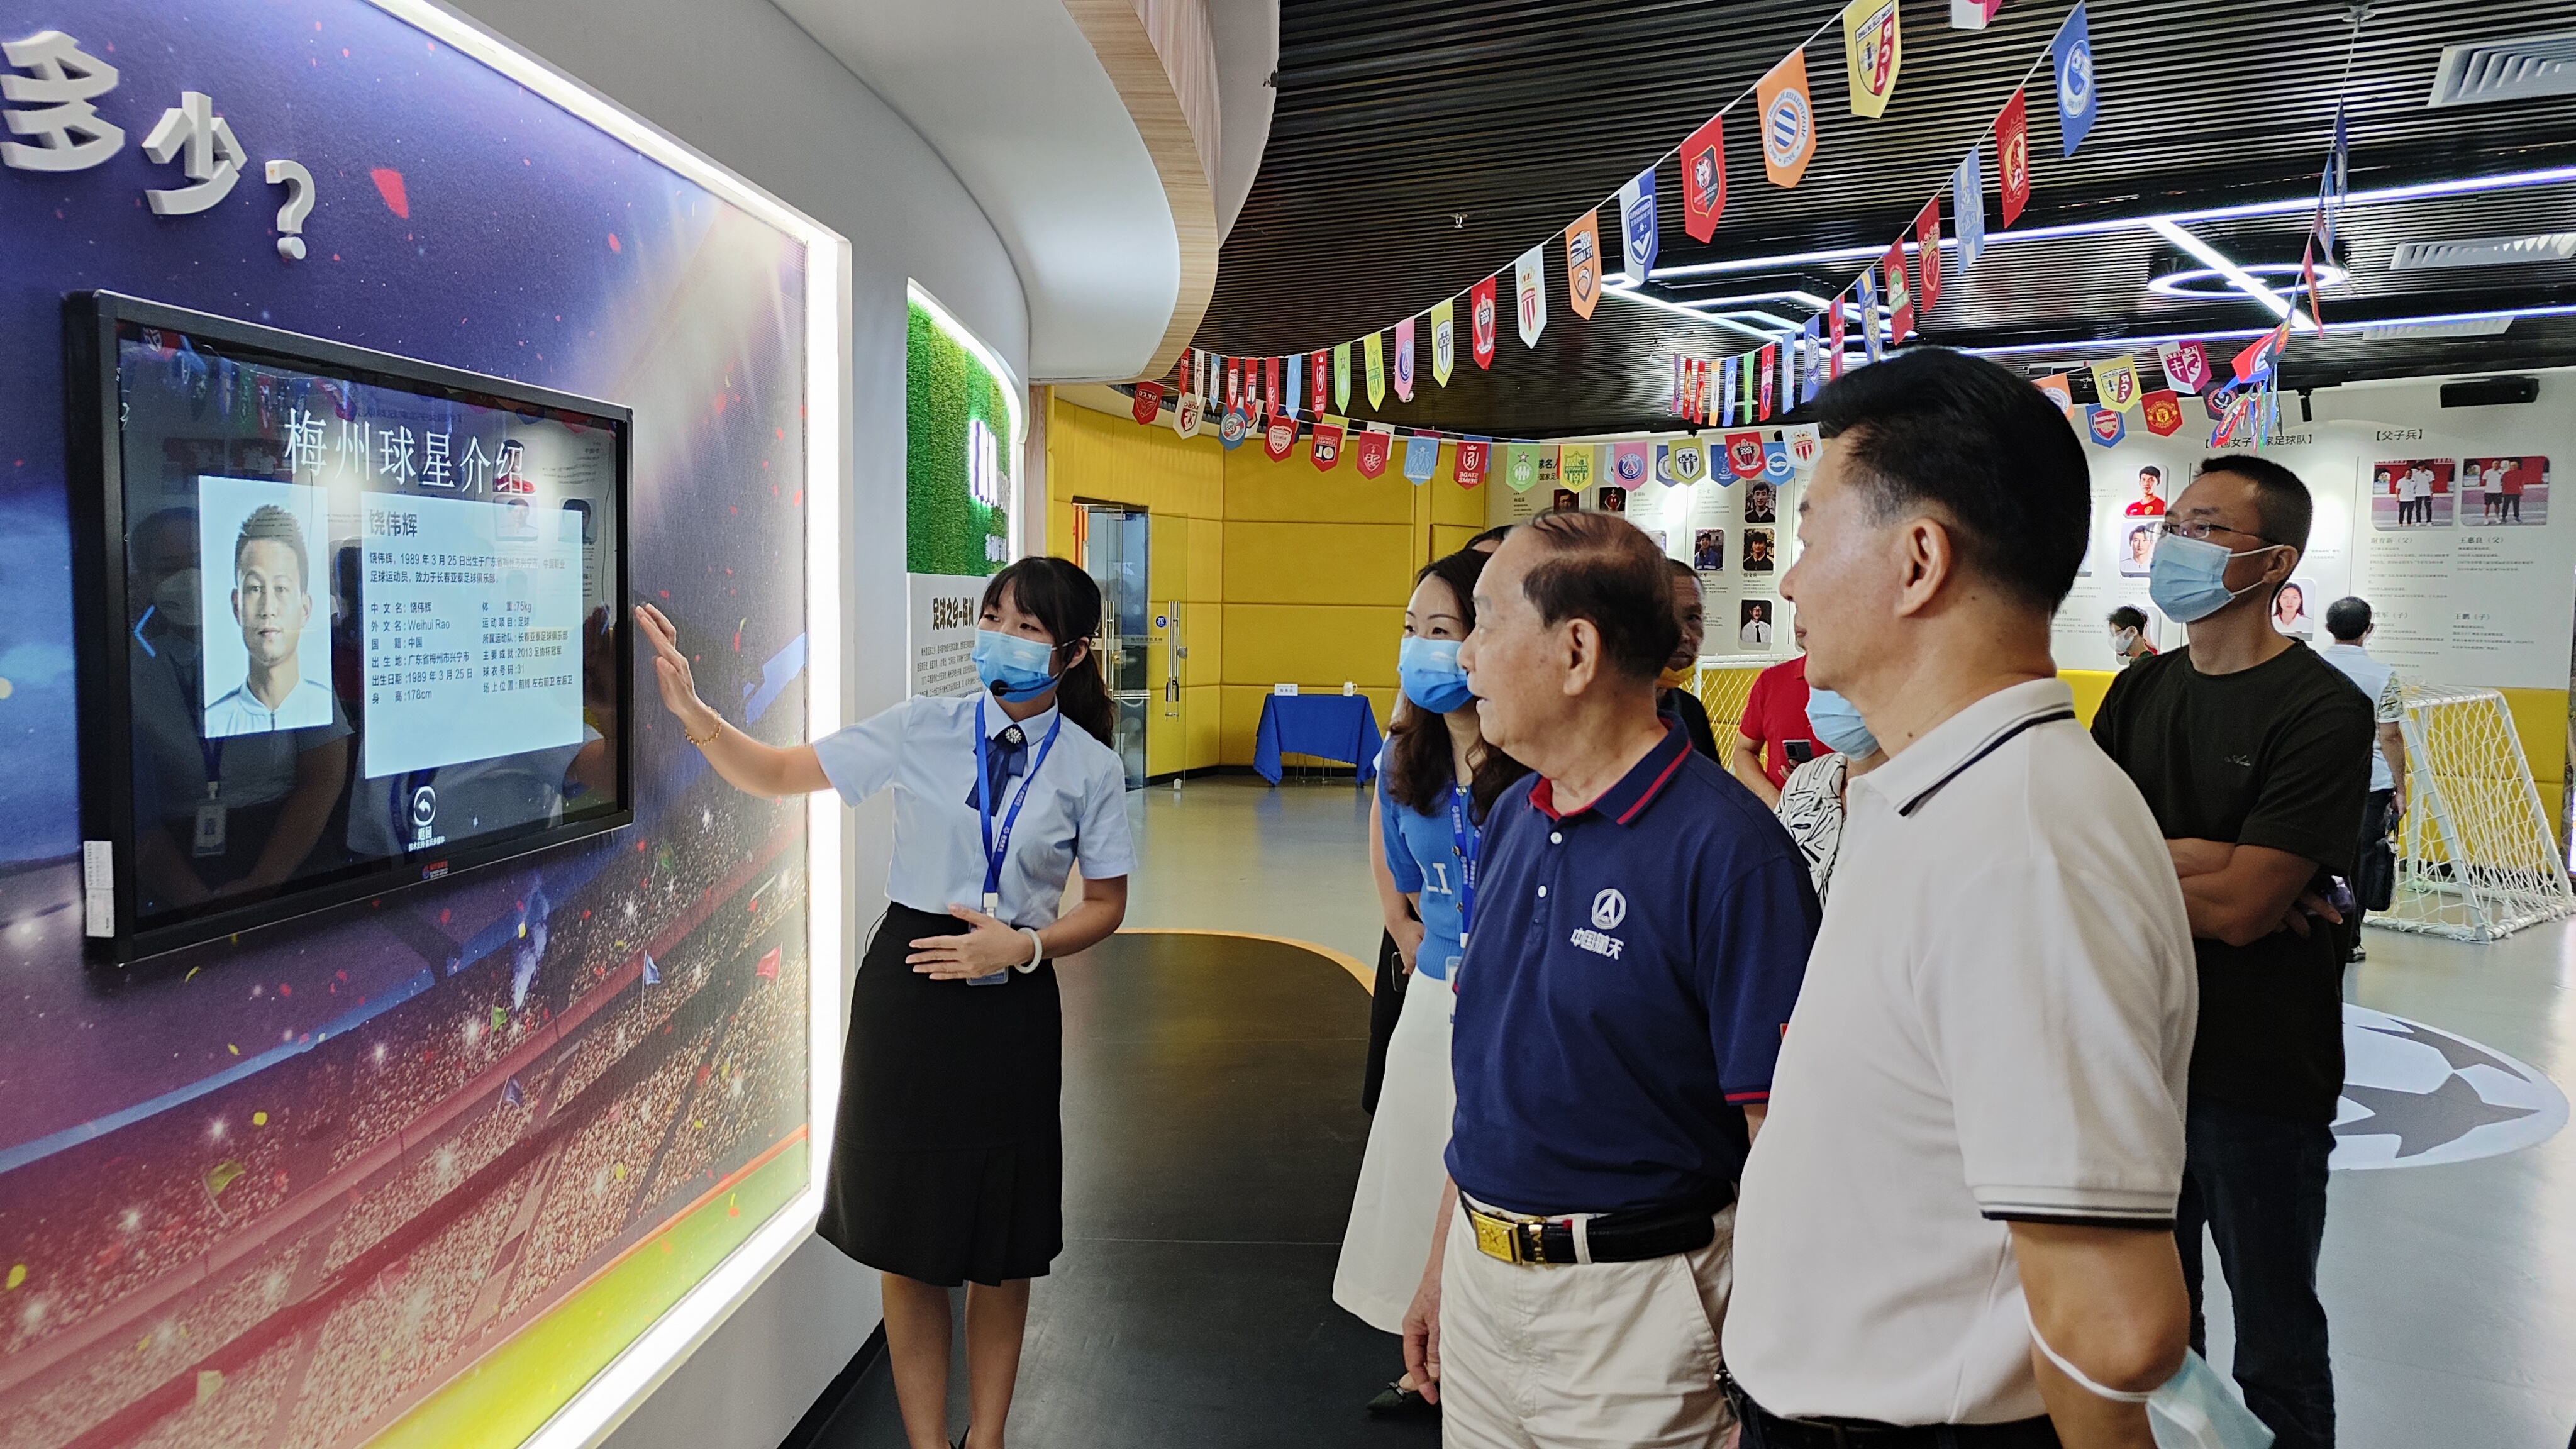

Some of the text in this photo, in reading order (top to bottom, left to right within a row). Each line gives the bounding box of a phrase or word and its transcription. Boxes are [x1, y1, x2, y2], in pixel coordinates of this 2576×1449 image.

[283, 406, 526, 494] 梅州球星介绍
[2376, 428, 2424, 441] 【父子兵】
[369, 508, 418, 539] 饶伟辉
[435, 619, 450, 630] Rao
[1570, 927, 1624, 960] 中国航天
